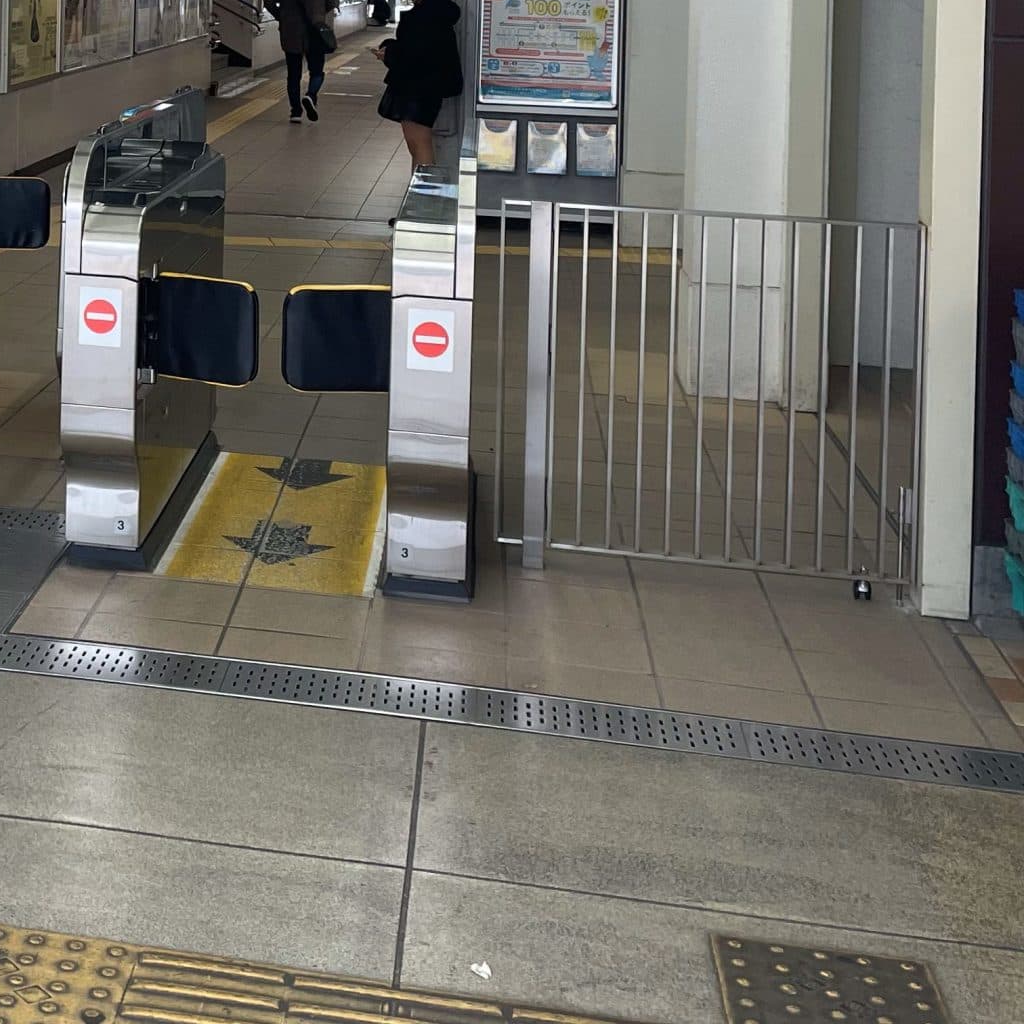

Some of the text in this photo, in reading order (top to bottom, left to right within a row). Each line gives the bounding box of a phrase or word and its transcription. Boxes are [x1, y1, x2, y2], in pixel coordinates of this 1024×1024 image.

[525, 0, 562, 16] 100
[118, 520, 124, 530] 3
[401, 548, 408, 558] 3
